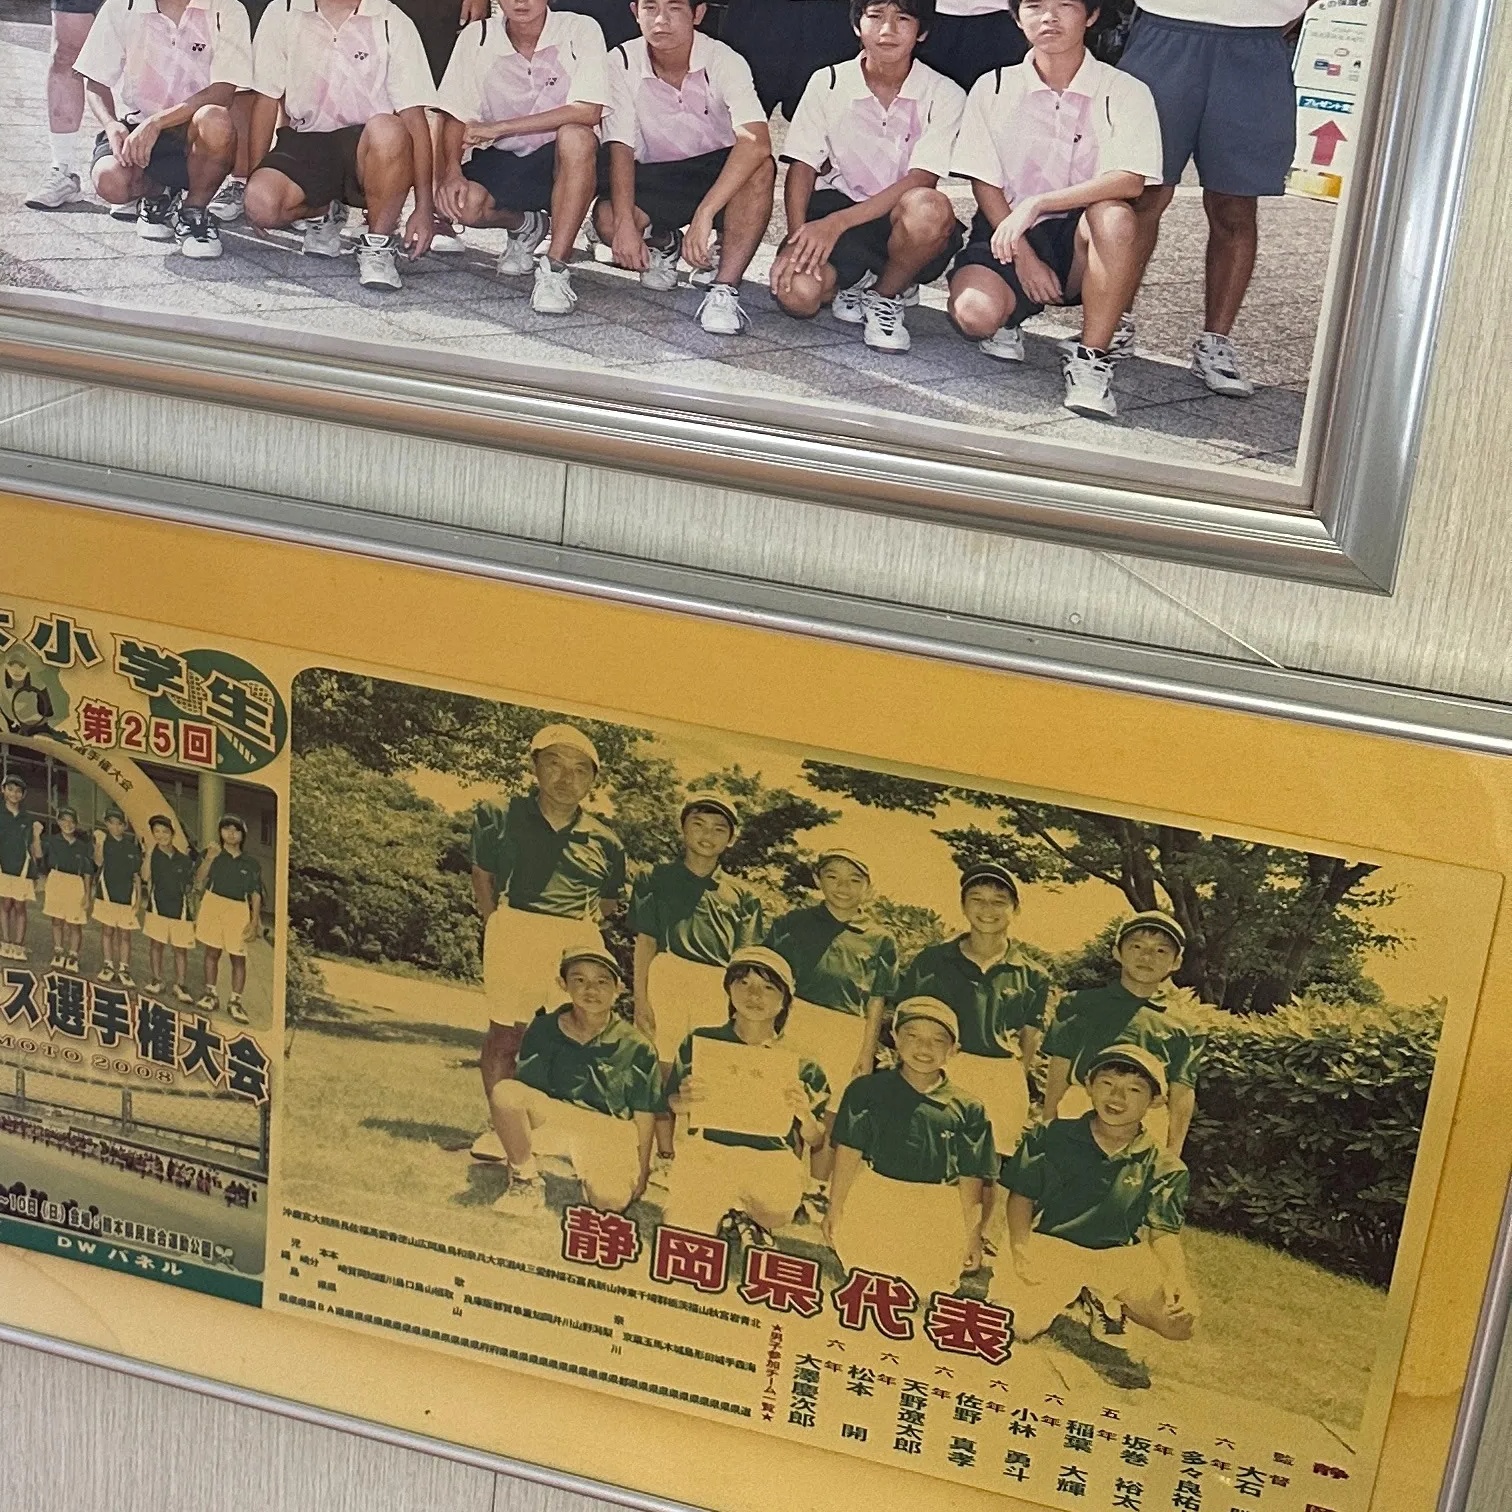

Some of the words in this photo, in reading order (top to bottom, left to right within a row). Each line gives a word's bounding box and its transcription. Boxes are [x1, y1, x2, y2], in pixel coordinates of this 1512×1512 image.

[76, 697, 218, 770] 第25回
[93, 1054, 175, 1086] 2008
[562, 1204, 1014, 1365] 静岡県代表
